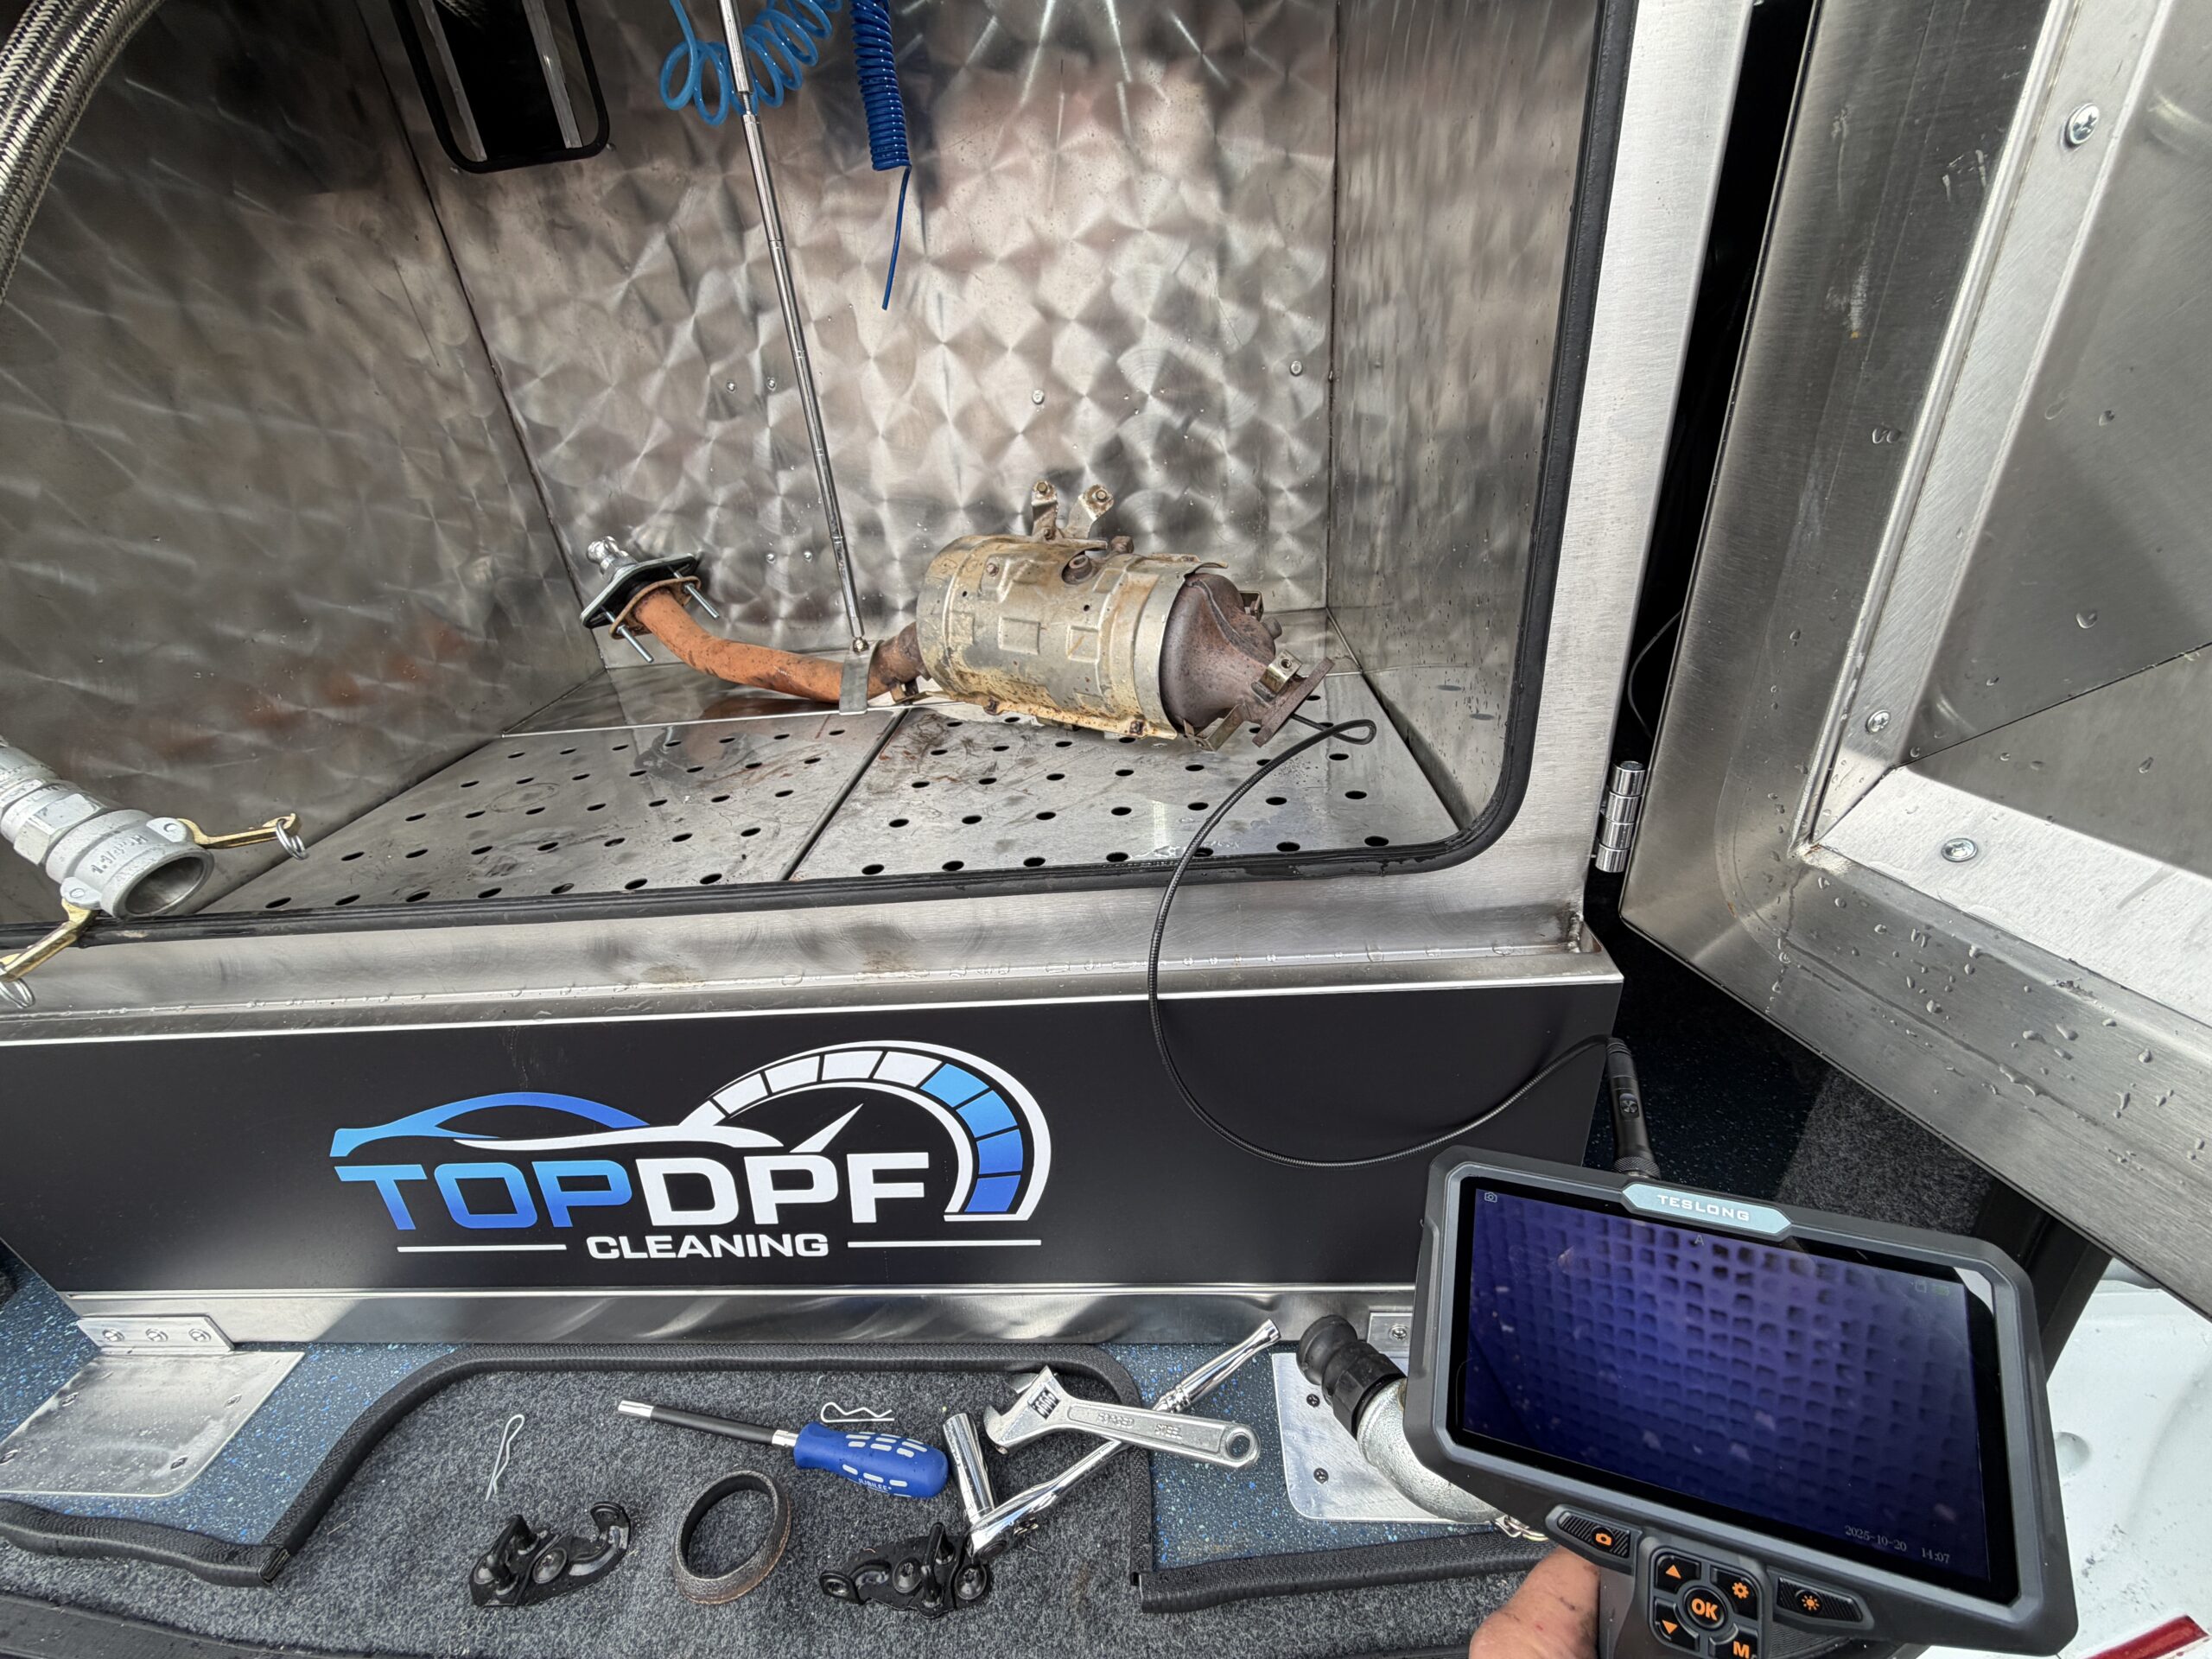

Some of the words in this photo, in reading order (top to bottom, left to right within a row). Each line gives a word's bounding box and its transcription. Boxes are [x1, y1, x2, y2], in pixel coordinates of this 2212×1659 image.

[1657, 1194, 1750, 1222] TESLONG
[586, 1234, 830, 1260] CLEANING
[1844, 1524, 1908, 1552] 2025-10-20
[1921, 1547, 1951, 1564] 14:07
[1691, 1598, 1719, 1621] OK
[1732, 1640, 1751, 1659] M
